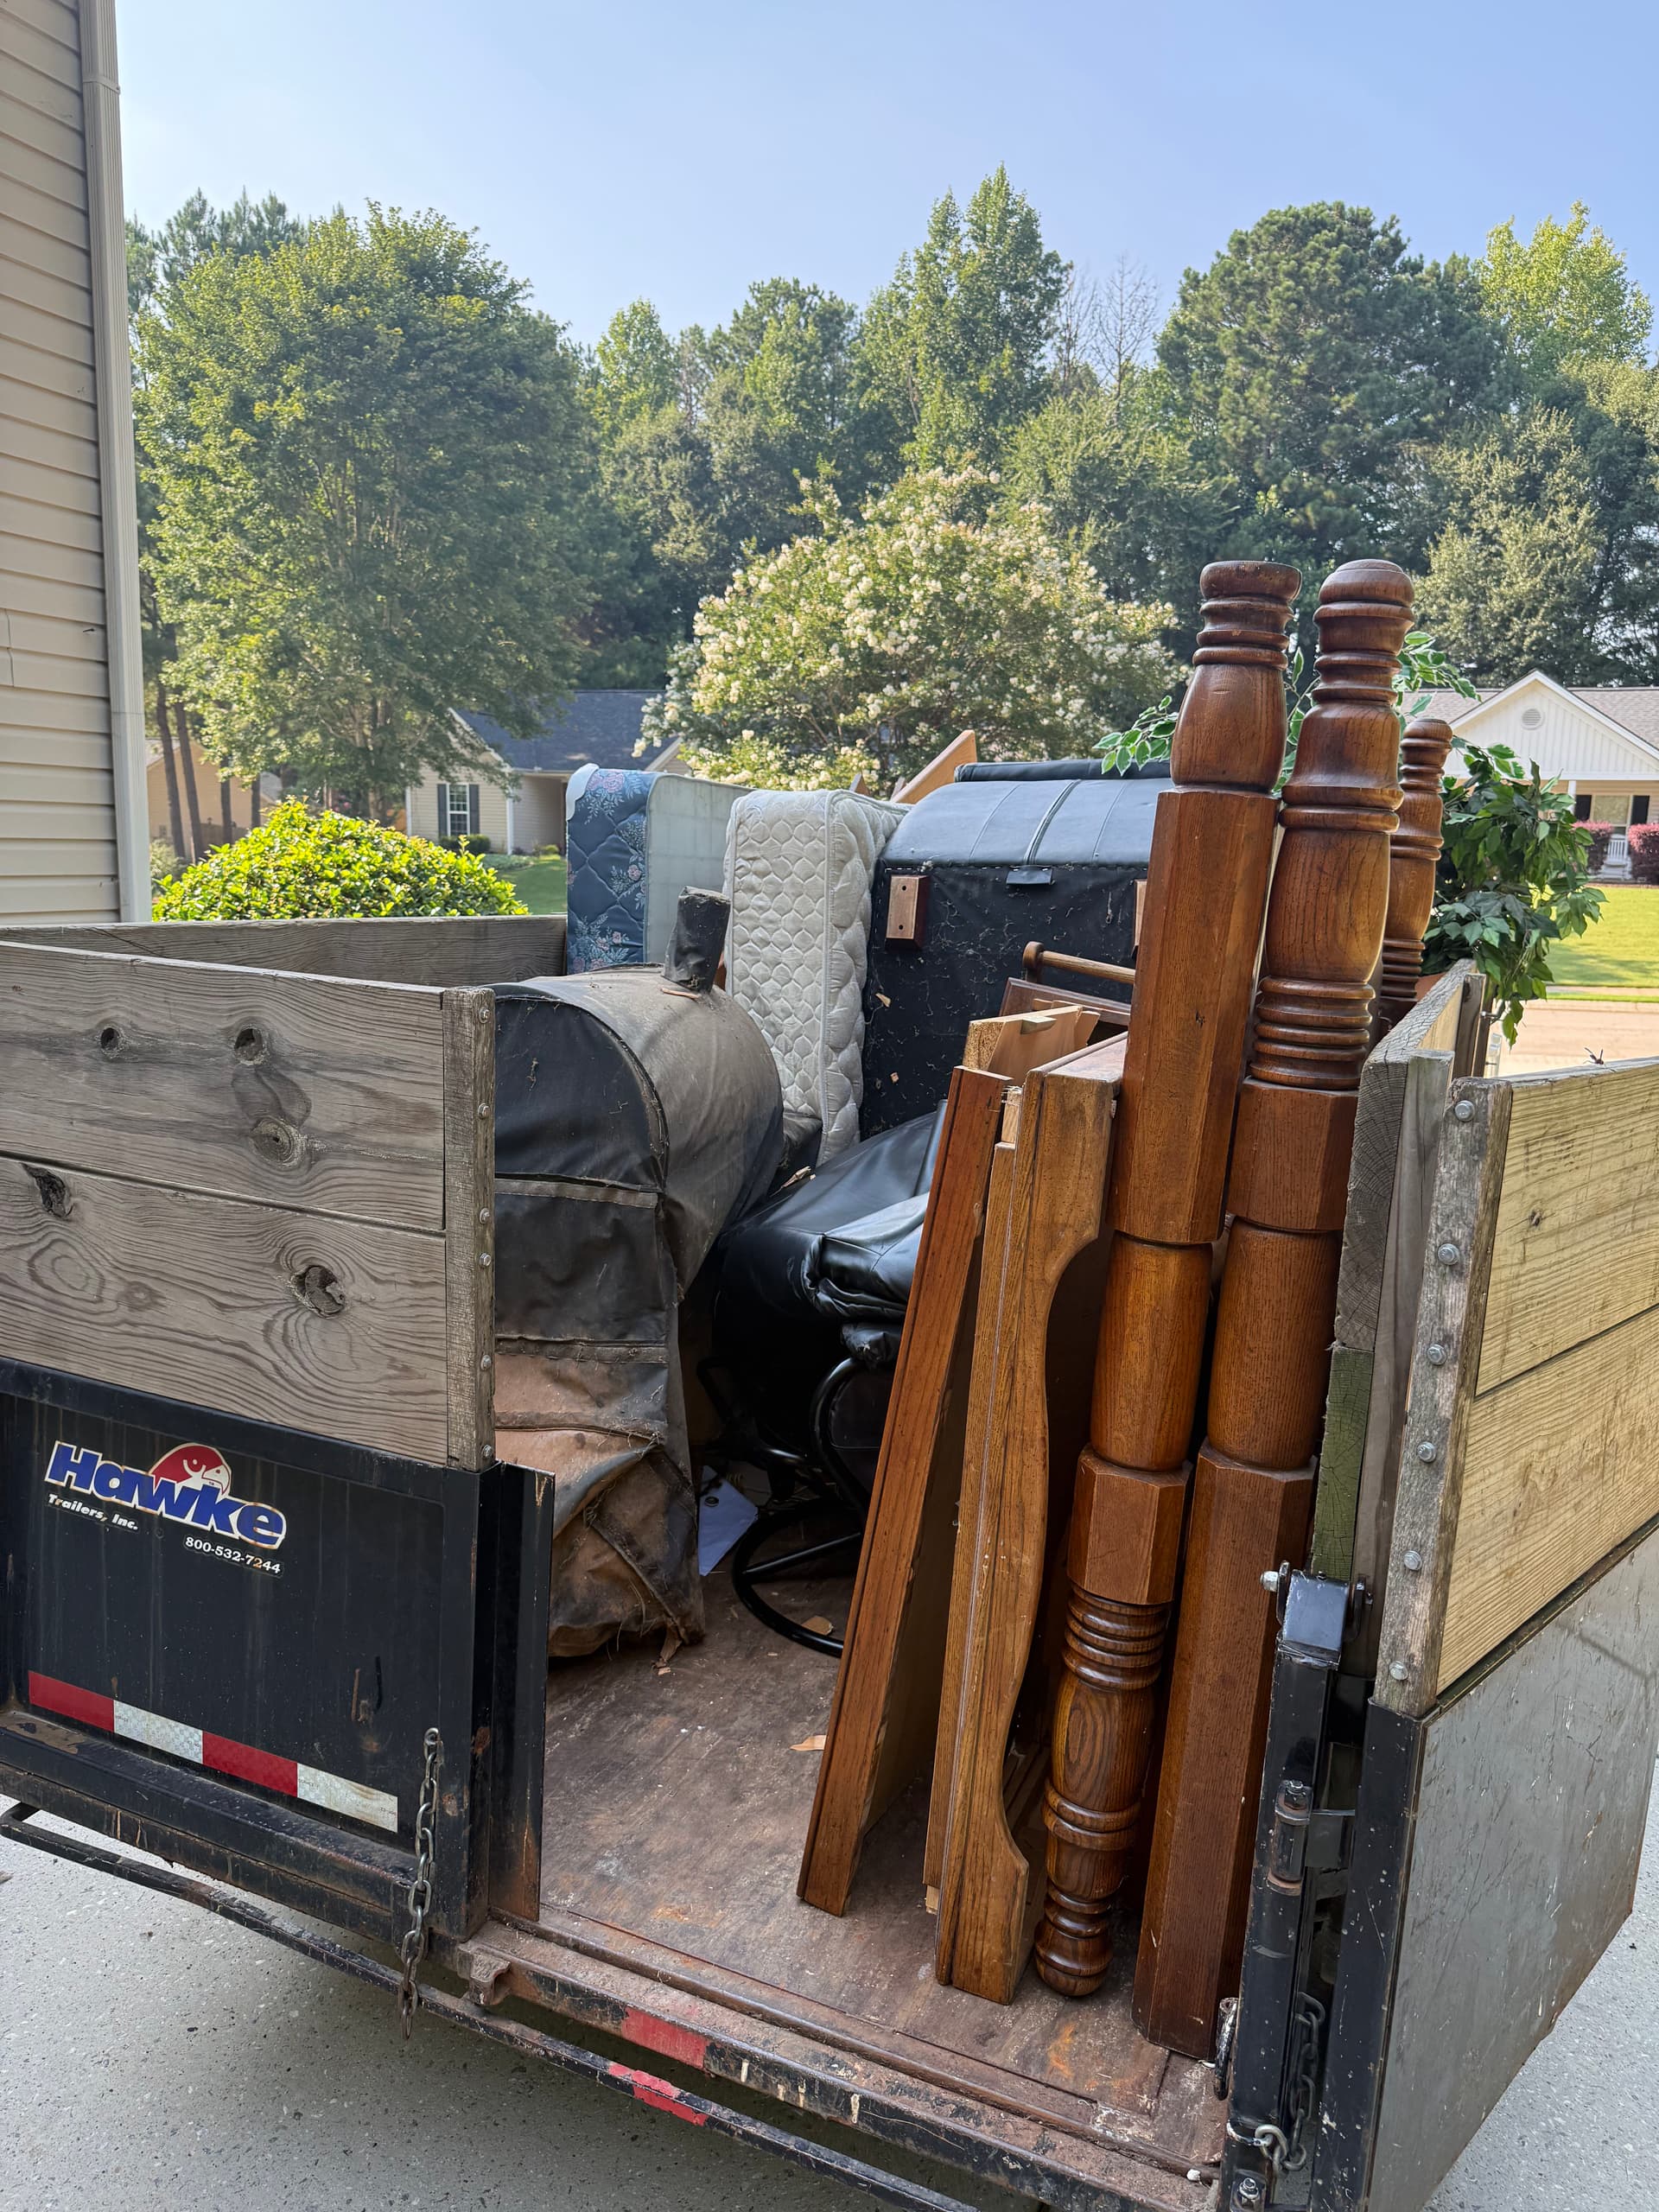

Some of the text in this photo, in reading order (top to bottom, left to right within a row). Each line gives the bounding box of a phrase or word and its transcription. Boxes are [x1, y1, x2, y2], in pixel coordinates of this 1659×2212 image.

[45, 1440, 287, 1549] Hawke
[48, 1493, 138, 1530] Trailers, Inc.
[185, 1536, 281, 1573] 800-532-7244
